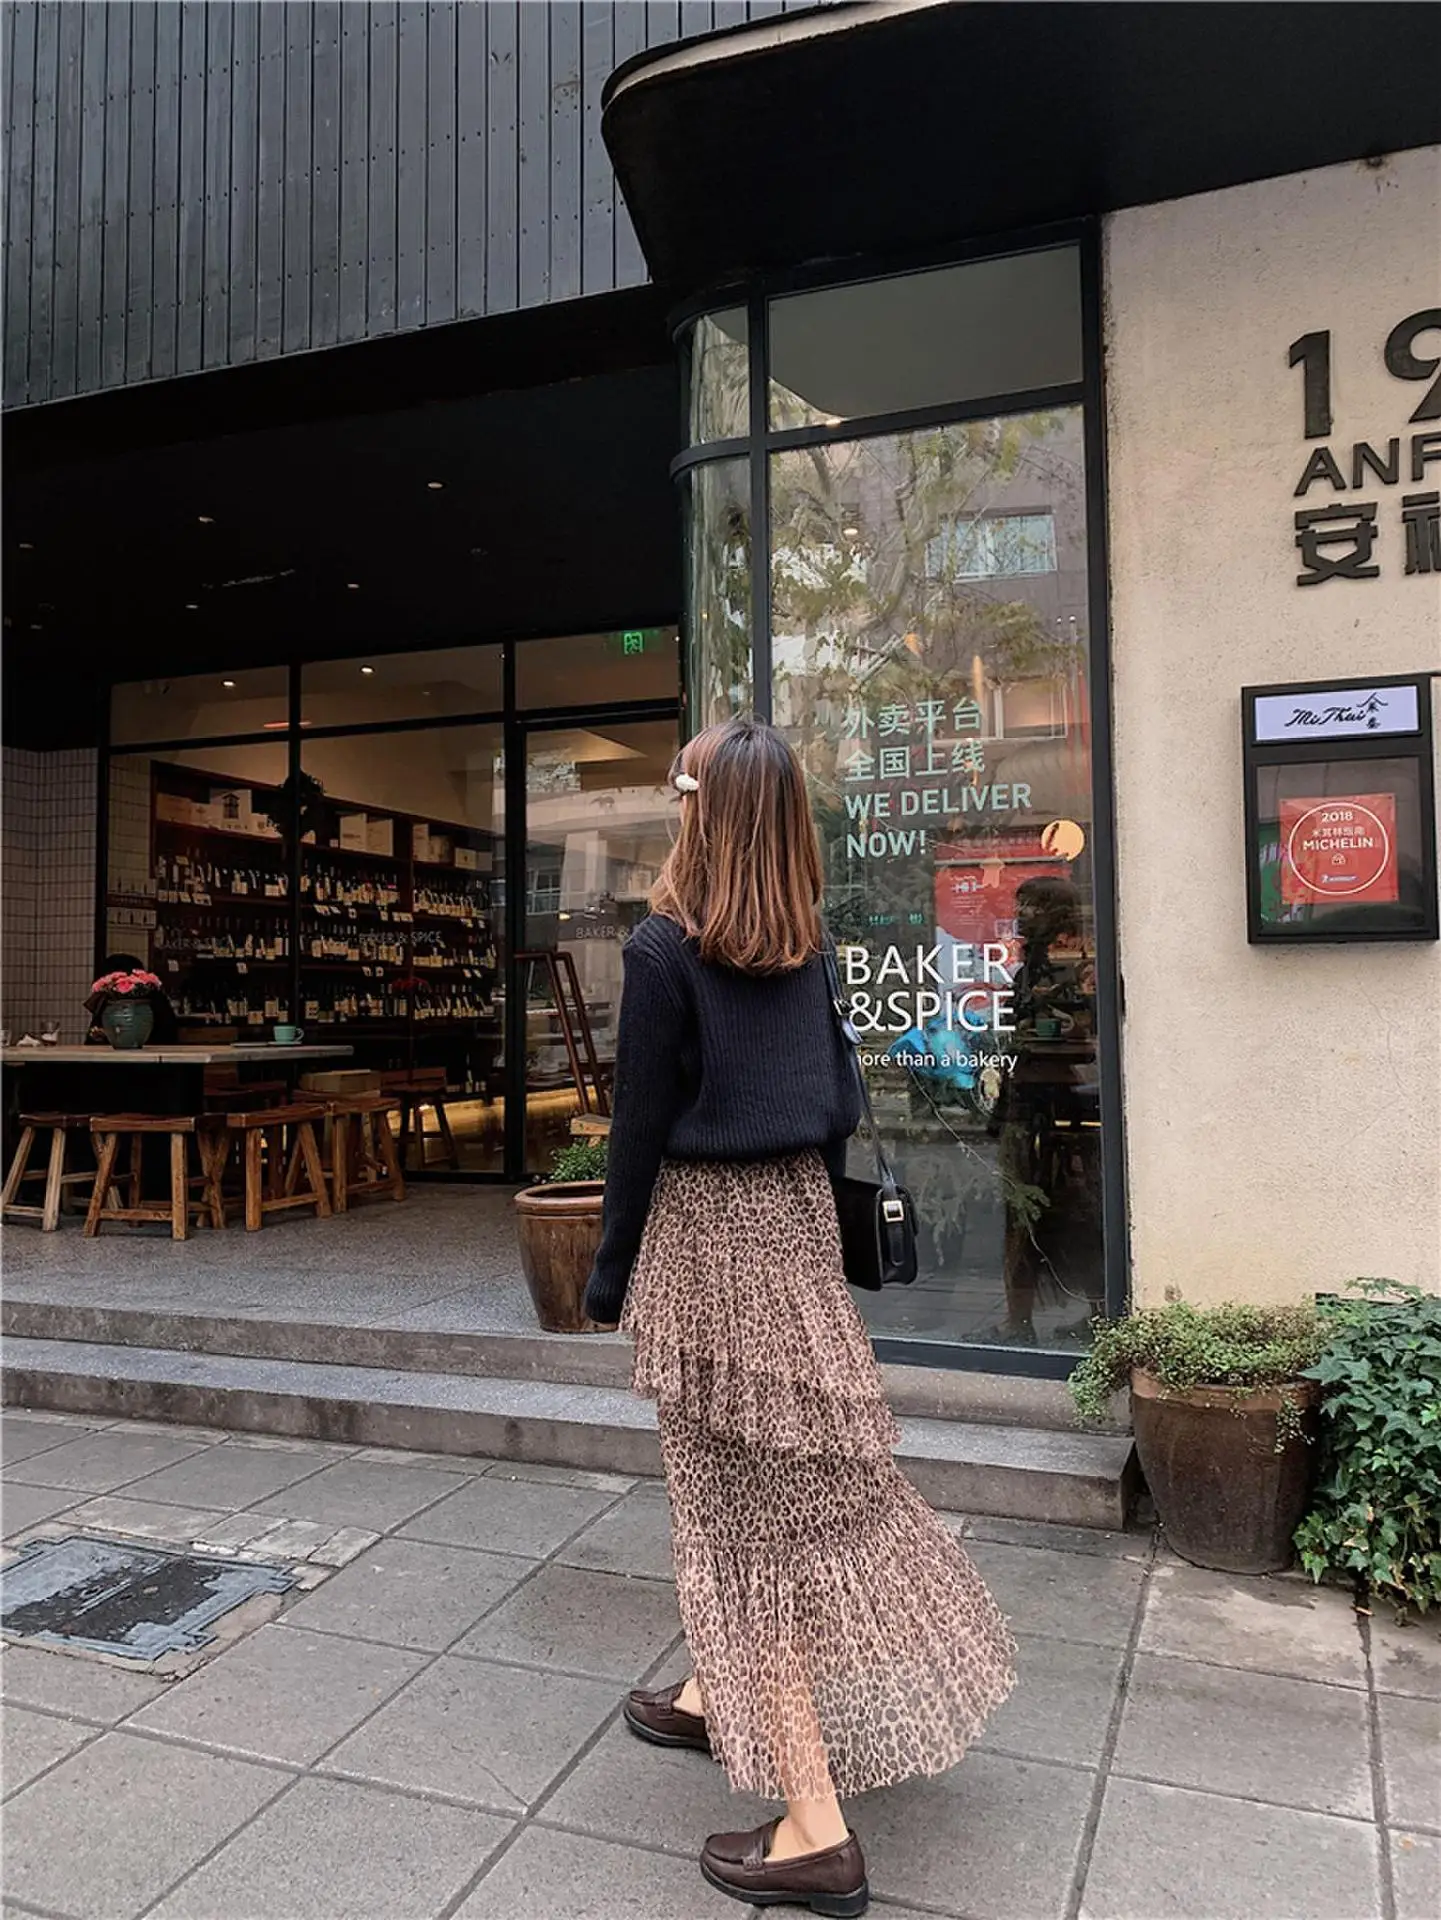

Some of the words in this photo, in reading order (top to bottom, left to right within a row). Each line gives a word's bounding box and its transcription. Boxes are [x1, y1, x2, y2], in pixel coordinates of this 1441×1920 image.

[1294, 431, 1441, 496] ANF
[841, 697, 982, 739] 外卖平台
[844, 740, 985, 782] 全国上线
[844, 792, 891, 819] WE
[901, 783, 1032, 816] DELIVER
[1321, 811, 1354, 823] 2018
[847, 830, 926, 859] NOW!
[1303, 837, 1374, 851] MICHELIN
[575, 924, 616, 939] BAKER
[845, 943, 1014, 985] BAKER
[849, 991, 1017, 1032] &SPICE
[857, 1053, 891, 1067] ore
[896, 1051, 935, 1067] than
[940, 1054, 951, 1067] a
[956, 1051, 1018, 1073] bakery
